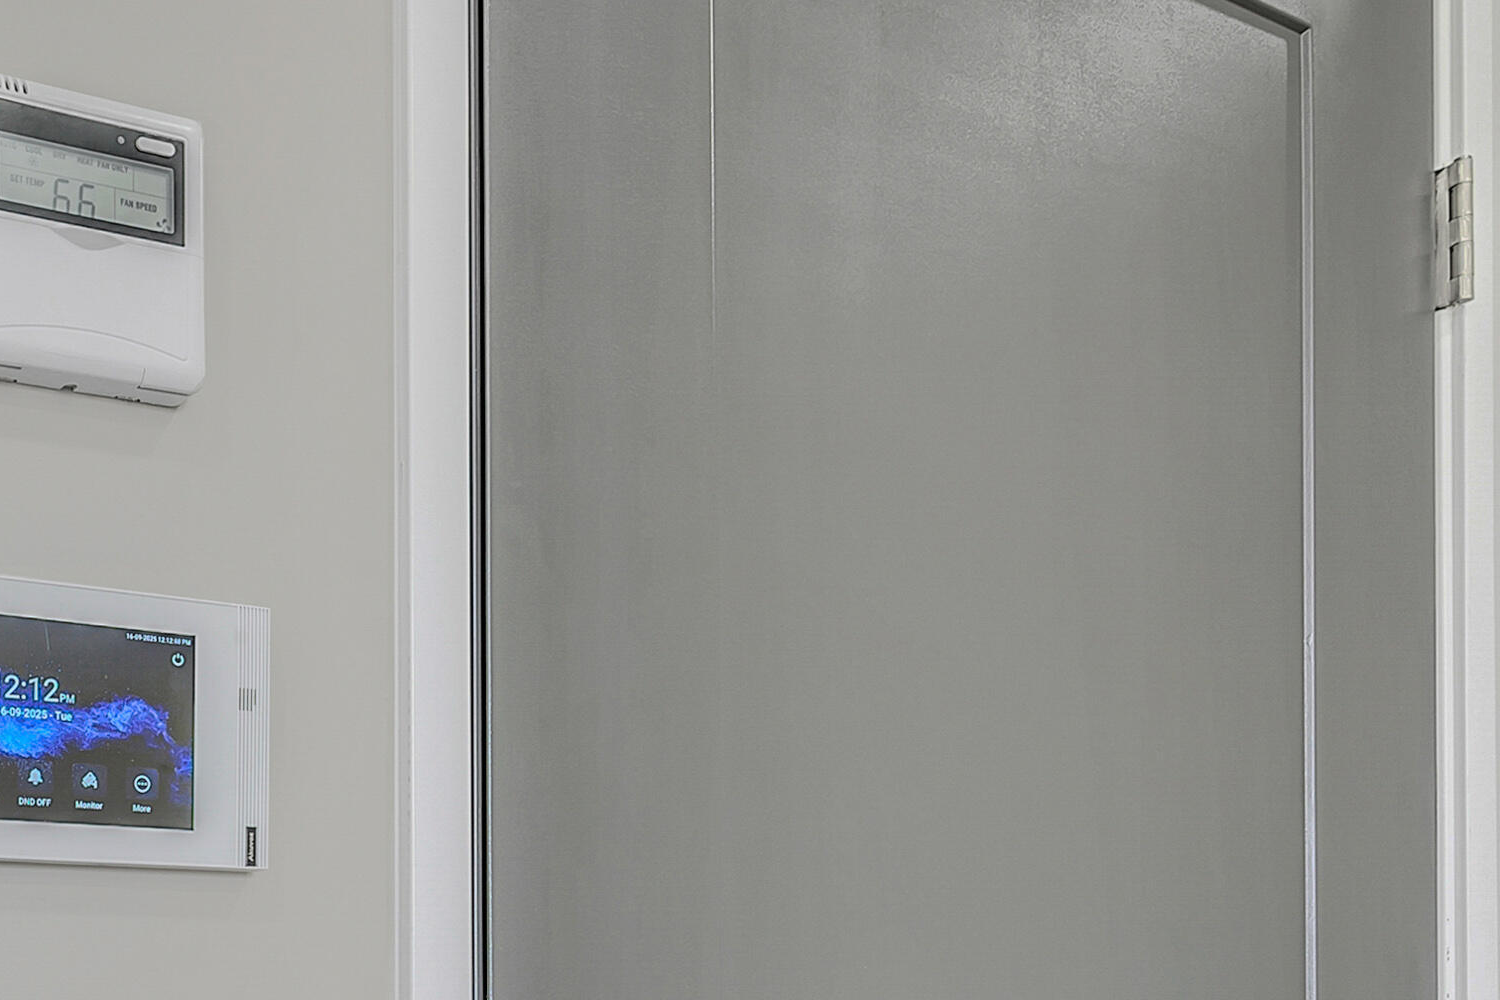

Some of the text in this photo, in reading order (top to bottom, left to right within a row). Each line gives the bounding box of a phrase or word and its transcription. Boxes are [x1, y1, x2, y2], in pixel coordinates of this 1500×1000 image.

[96, 160, 129, 174] FAN ONLY
[10, 174, 45, 187] SET TEMP
[120, 198, 158, 213] FAN SPEED
[126, 632, 158, 643] 16-09-2025
[54, 710, 73, 721] Tue
[18, 796, 52, 807] DND OFF
[75, 800, 104, 811] Monitor
[132, 804, 151, 814] More
